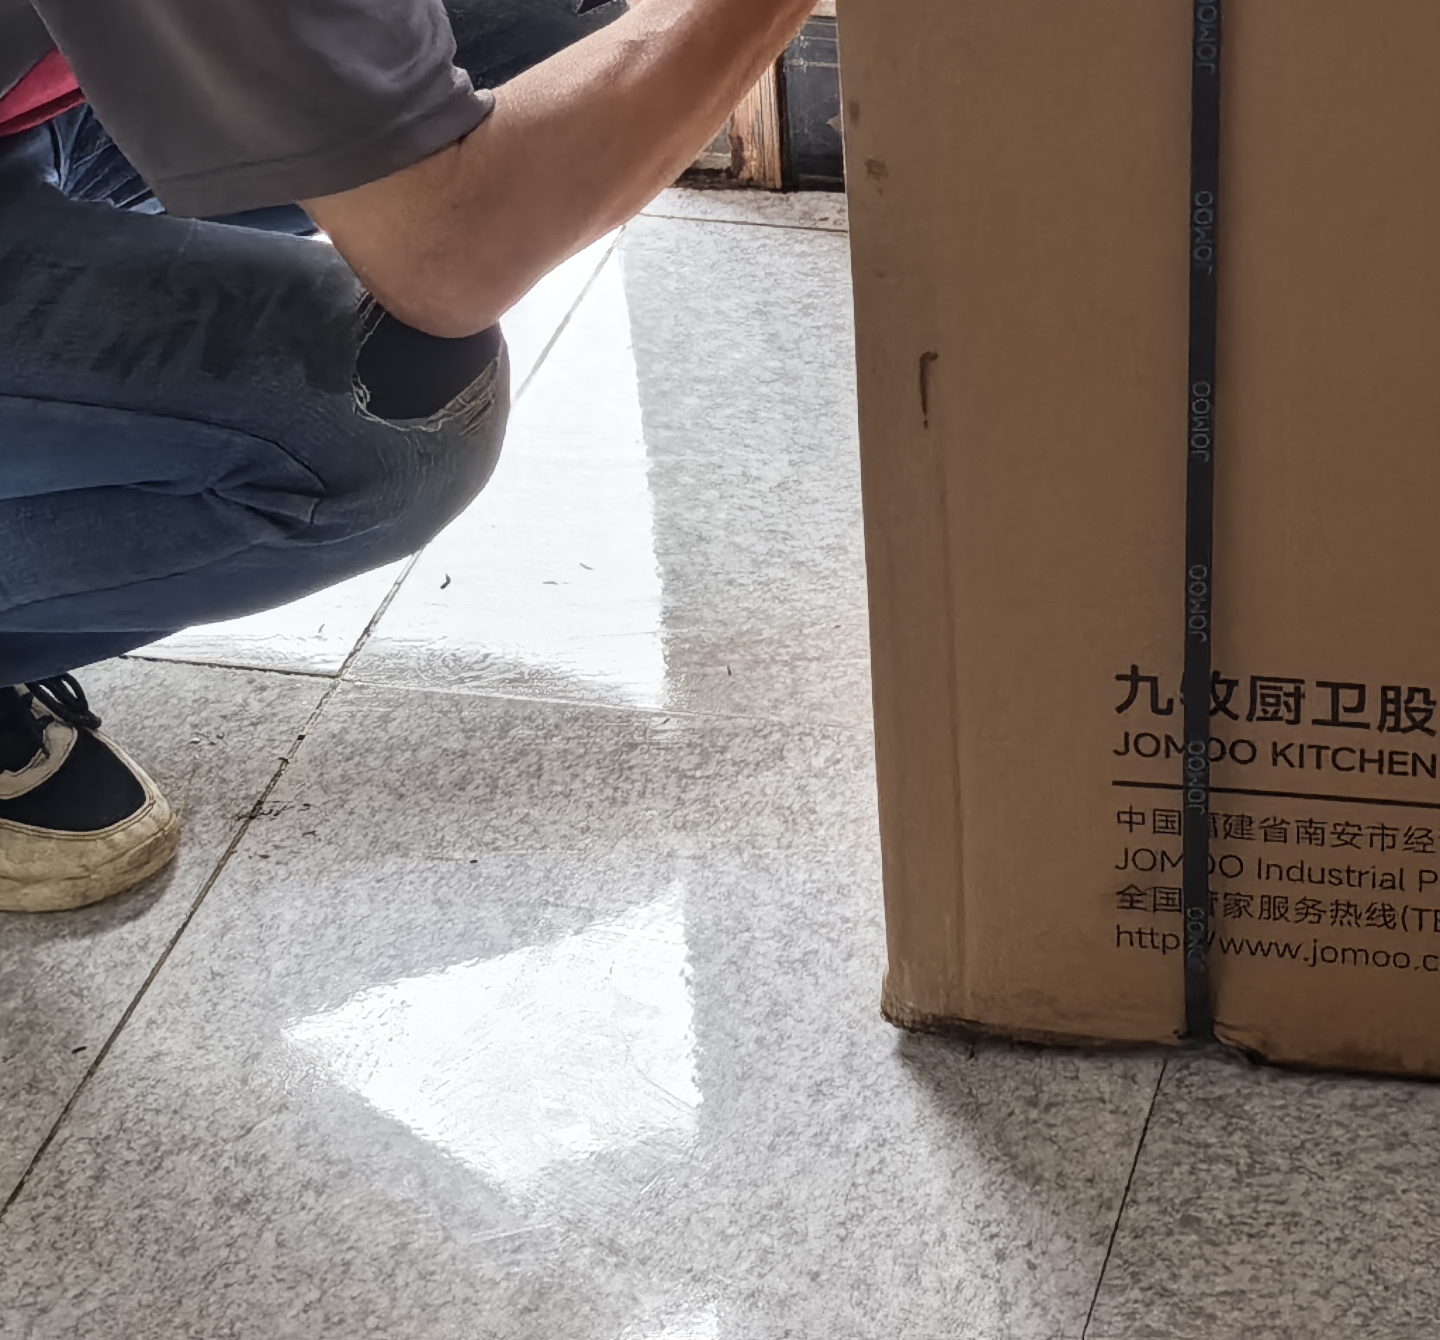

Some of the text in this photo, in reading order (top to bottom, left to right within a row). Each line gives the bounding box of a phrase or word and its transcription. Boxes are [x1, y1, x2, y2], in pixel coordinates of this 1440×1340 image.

[1193, 190, 1214, 276] JOMOO
[1191, 381, 1210, 463] JOMOO
[1188, 564, 1208, 643] JOMOO
[1271, 740, 1437, 779] KITCHEN
[1115, 847, 1244, 879] JOMO
[1256, 857, 1406, 892] Industrial
